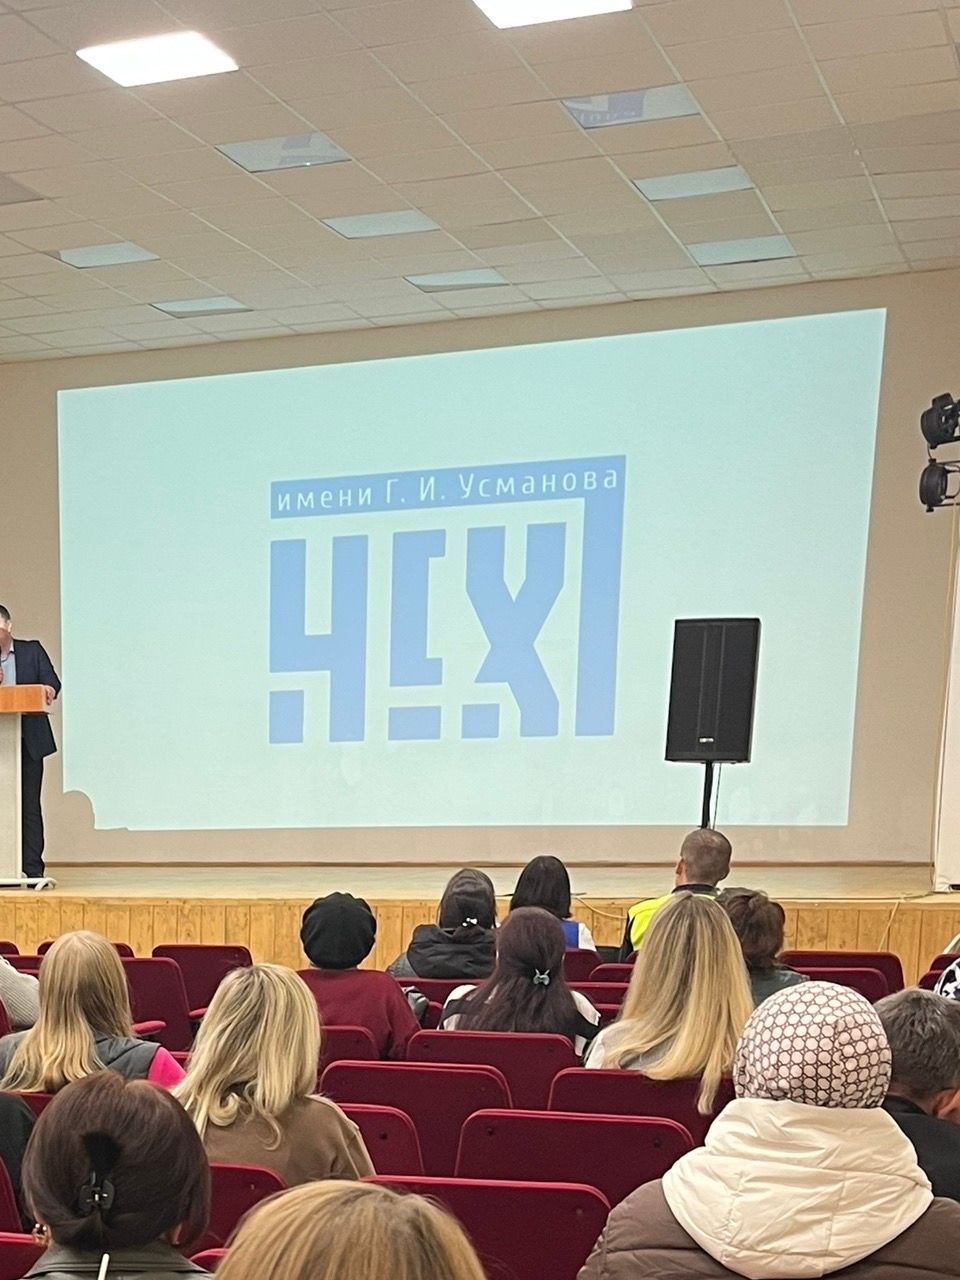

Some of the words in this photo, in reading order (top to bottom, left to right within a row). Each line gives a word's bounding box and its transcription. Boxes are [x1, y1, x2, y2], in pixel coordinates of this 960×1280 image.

[277, 486, 372, 511] имени
[385, 479, 406, 504] Г.
[420, 476, 446, 501] И.
[458, 469, 618, 499] Усманова
